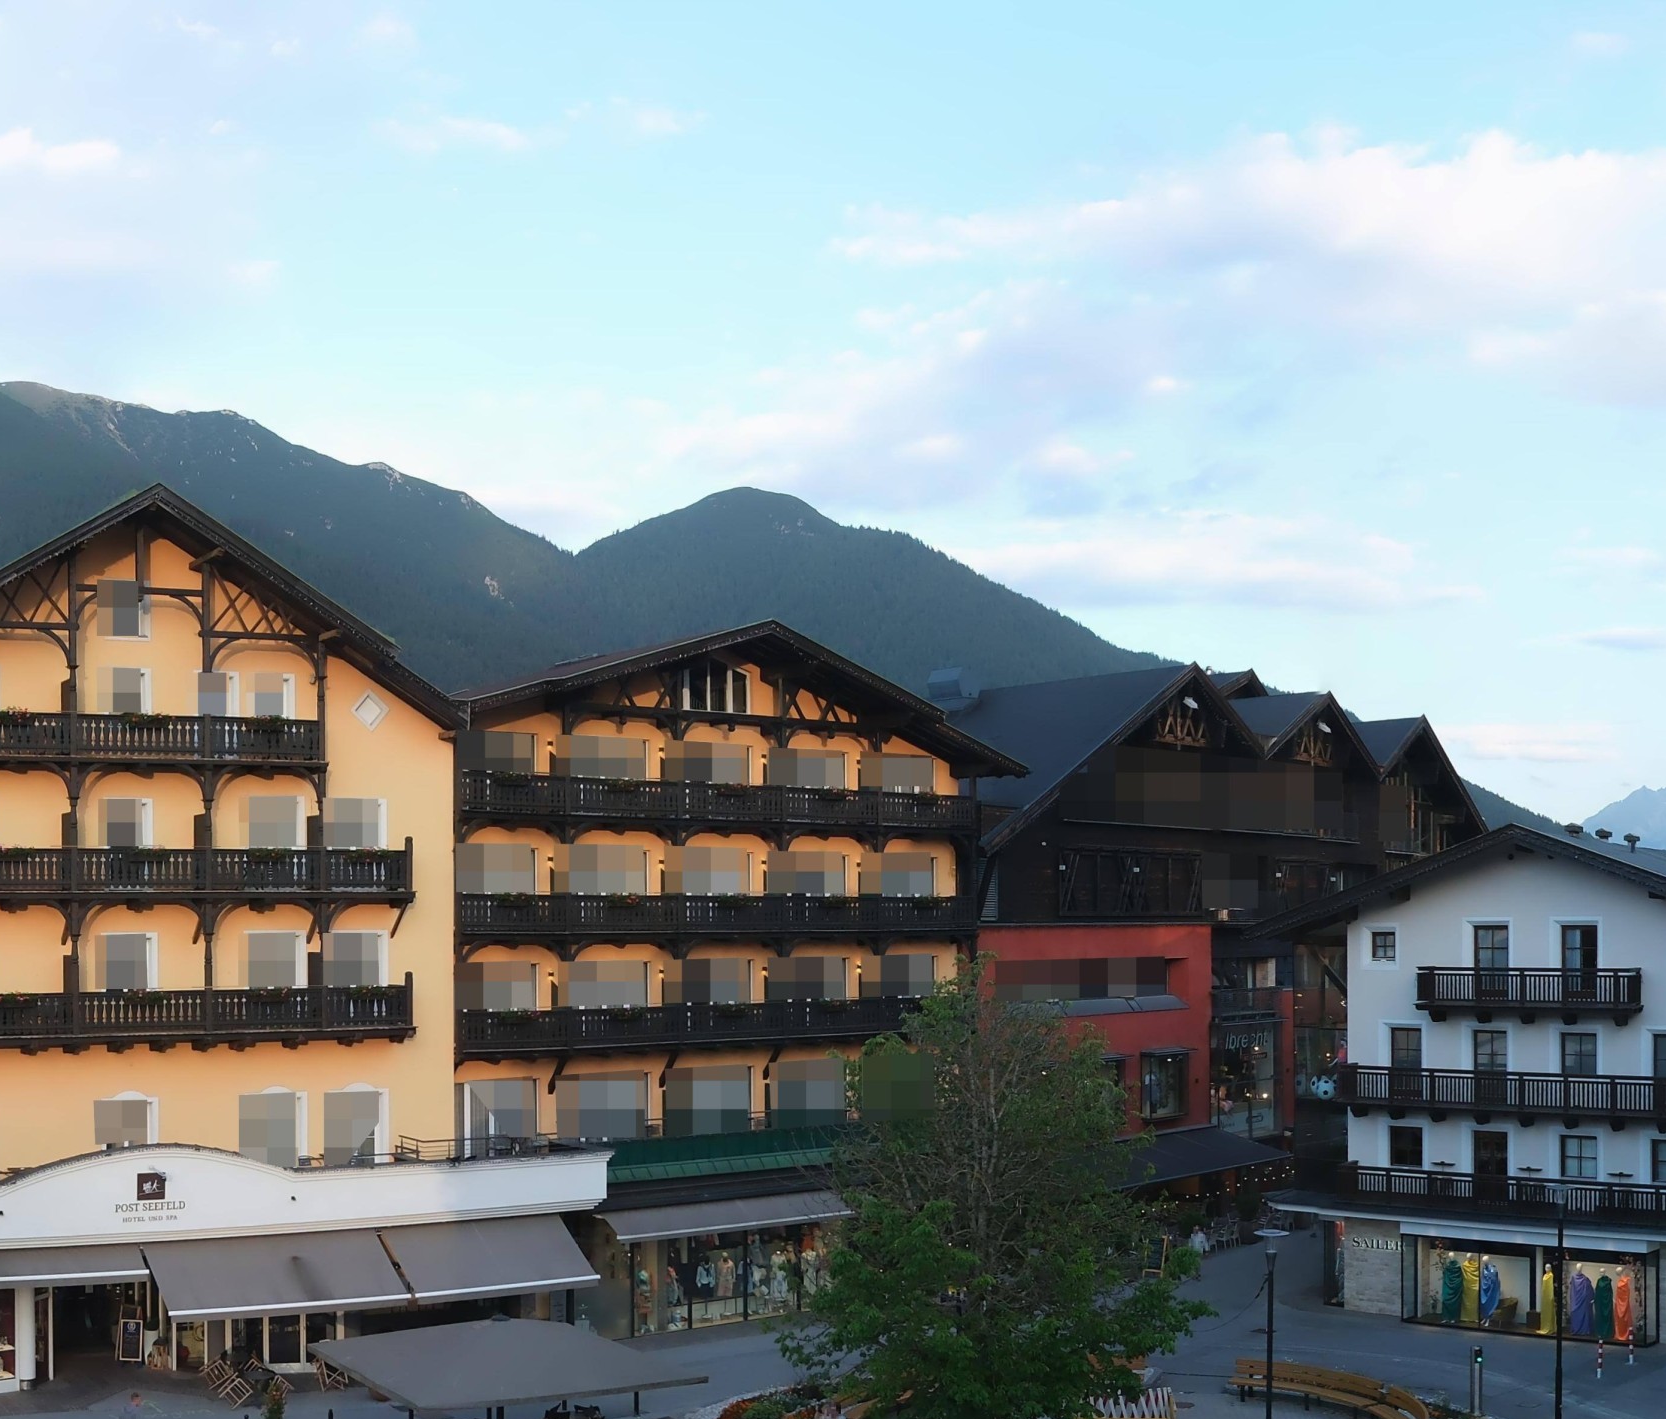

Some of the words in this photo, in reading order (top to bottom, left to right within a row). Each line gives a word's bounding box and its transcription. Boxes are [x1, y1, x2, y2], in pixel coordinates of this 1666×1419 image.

[115, 1203, 140, 1213] POST
[142, 1201, 186, 1212] SEEFELD
[1352, 1235, 1406, 1251] SAILER
